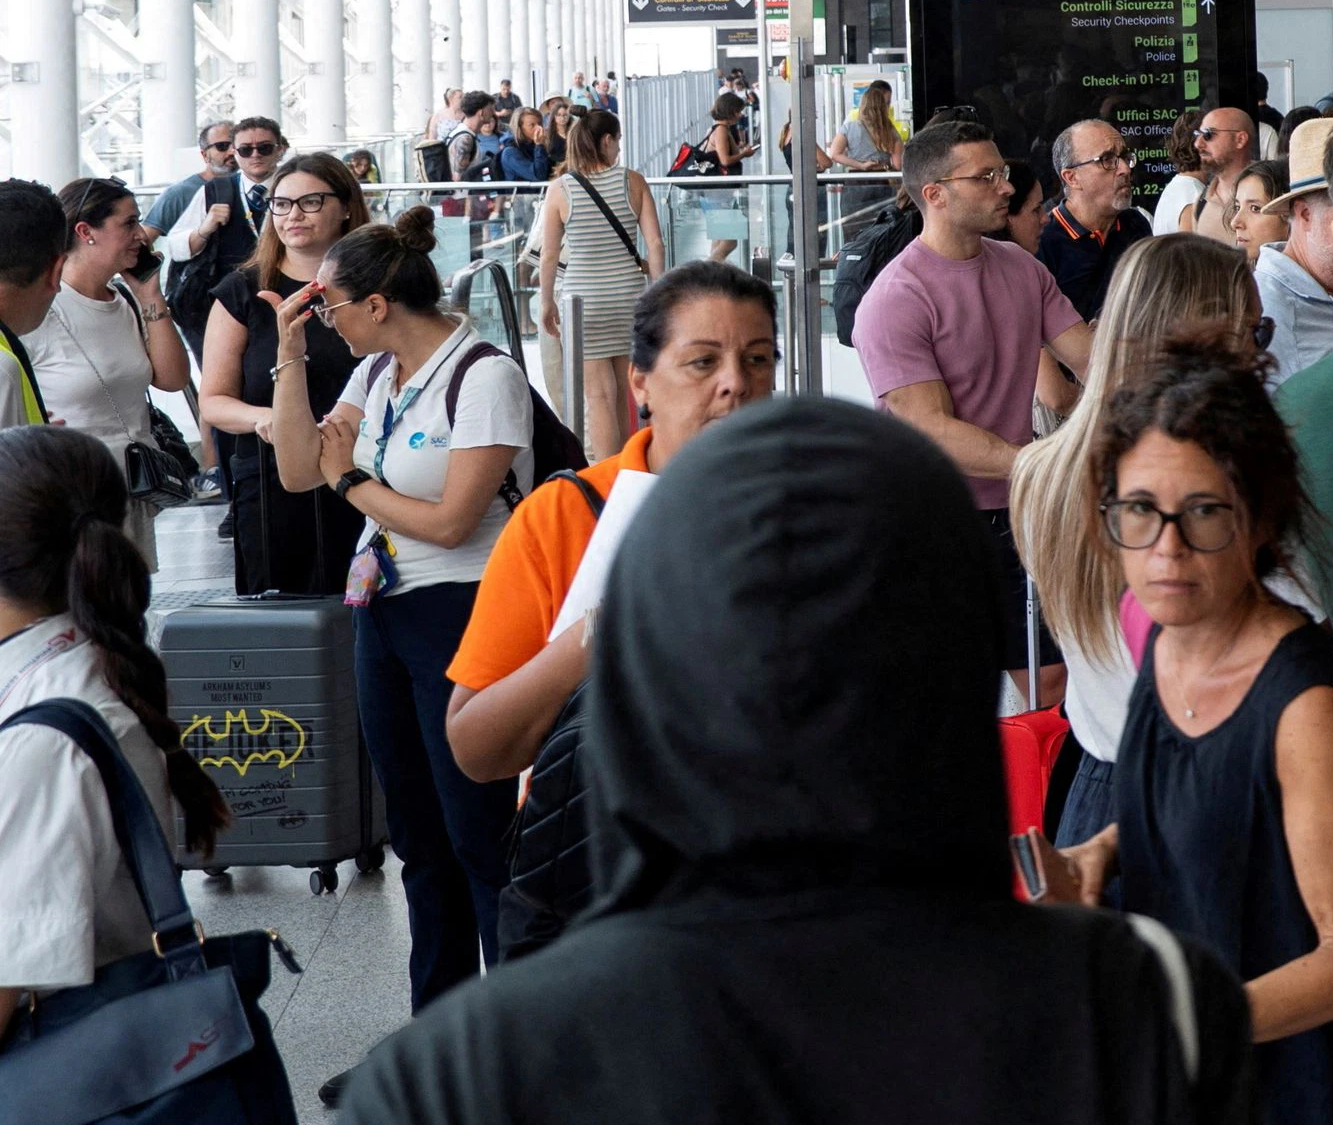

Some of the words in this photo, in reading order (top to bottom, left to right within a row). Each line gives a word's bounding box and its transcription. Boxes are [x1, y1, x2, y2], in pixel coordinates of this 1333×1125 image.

[656, 5, 676, 13] Gates
[682, 4, 706, 13] Security
[707, 3, 728, 12] Check
[1060, 0, 1112, 13] Controlli
[1115, 0, 1174, 11] Sicurezza
[1071, 17, 1111, 29] Security
[1114, 15, 1175, 27] Checkpoints
[1134, 36, 1175, 48] Polizia
[1146, 51, 1176, 62] Police
[1082, 73, 1137, 87] Check-in
[1140, 73, 1175, 85] 01-21
[1117, 109, 1149, 121] Uffici
[1153, 108, 1178, 120] SAC
[1120, 127, 1142, 136] SAC
[430, 437, 447, 445] SAC
[202, 682, 234, 692] ARKHAM
[210, 694, 231, 703] MOST
[232, 692, 263, 702] WANTED
[184, 726, 217, 761] HE
[228, 725, 315, 761] JOKER
